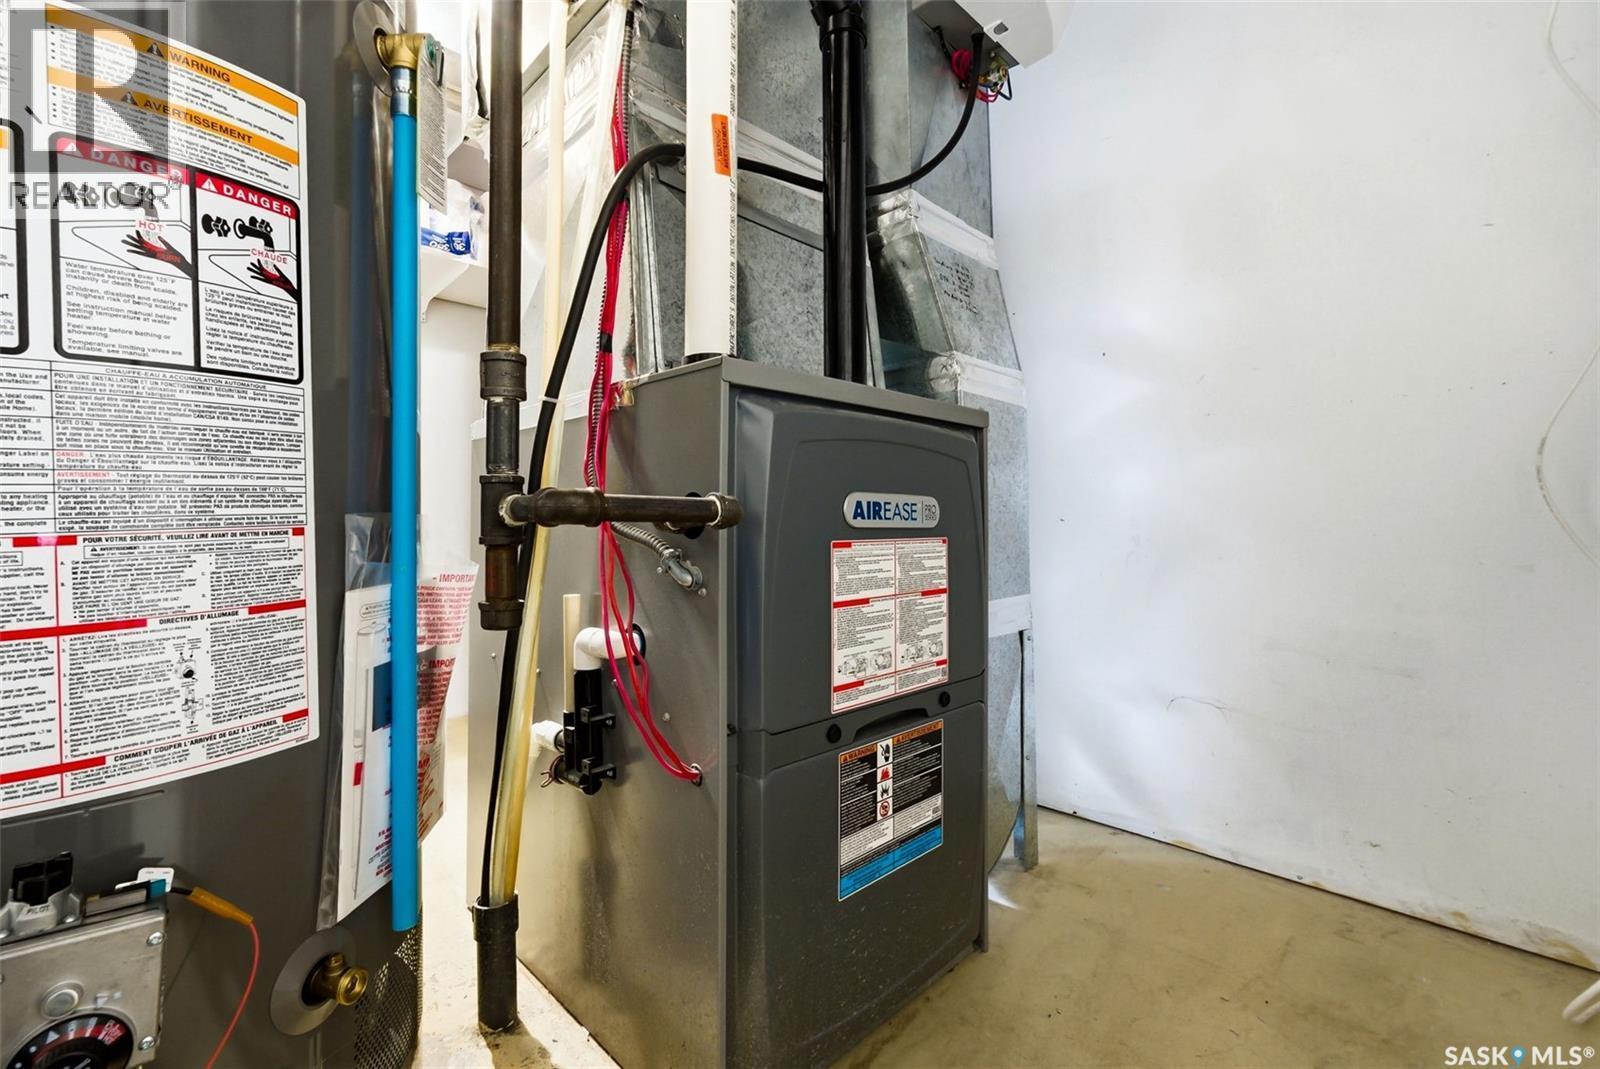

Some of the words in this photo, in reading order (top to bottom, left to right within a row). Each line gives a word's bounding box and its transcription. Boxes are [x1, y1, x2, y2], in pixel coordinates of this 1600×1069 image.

[169, 50, 230, 82] WARNING
[144, 99, 254, 144] AVERTISSEMENT
[91, 144, 183, 180] DANGER
[223, 178, 292, 217] DANGER
[138, 220, 164, 233] HOT
[251, 247, 288, 265] CHAUDE
[852, 500, 918, 521] AIREASE
[924, 504, 937, 515] PRO
[166, 532, 195, 540] VEUILLEZ
[159, 615, 199, 625] DIRECTIVES
[200, 610, 239, 621] D'ALLUMAGE
[114, 749, 152, 762] COMMENT
[154, 743, 183, 753] COUPER
[184, 735, 217, 748] L'ARRIVÉE
[247, 720, 278, 732] L'APPAREIL
[26, 905, 49, 915] PILOT
